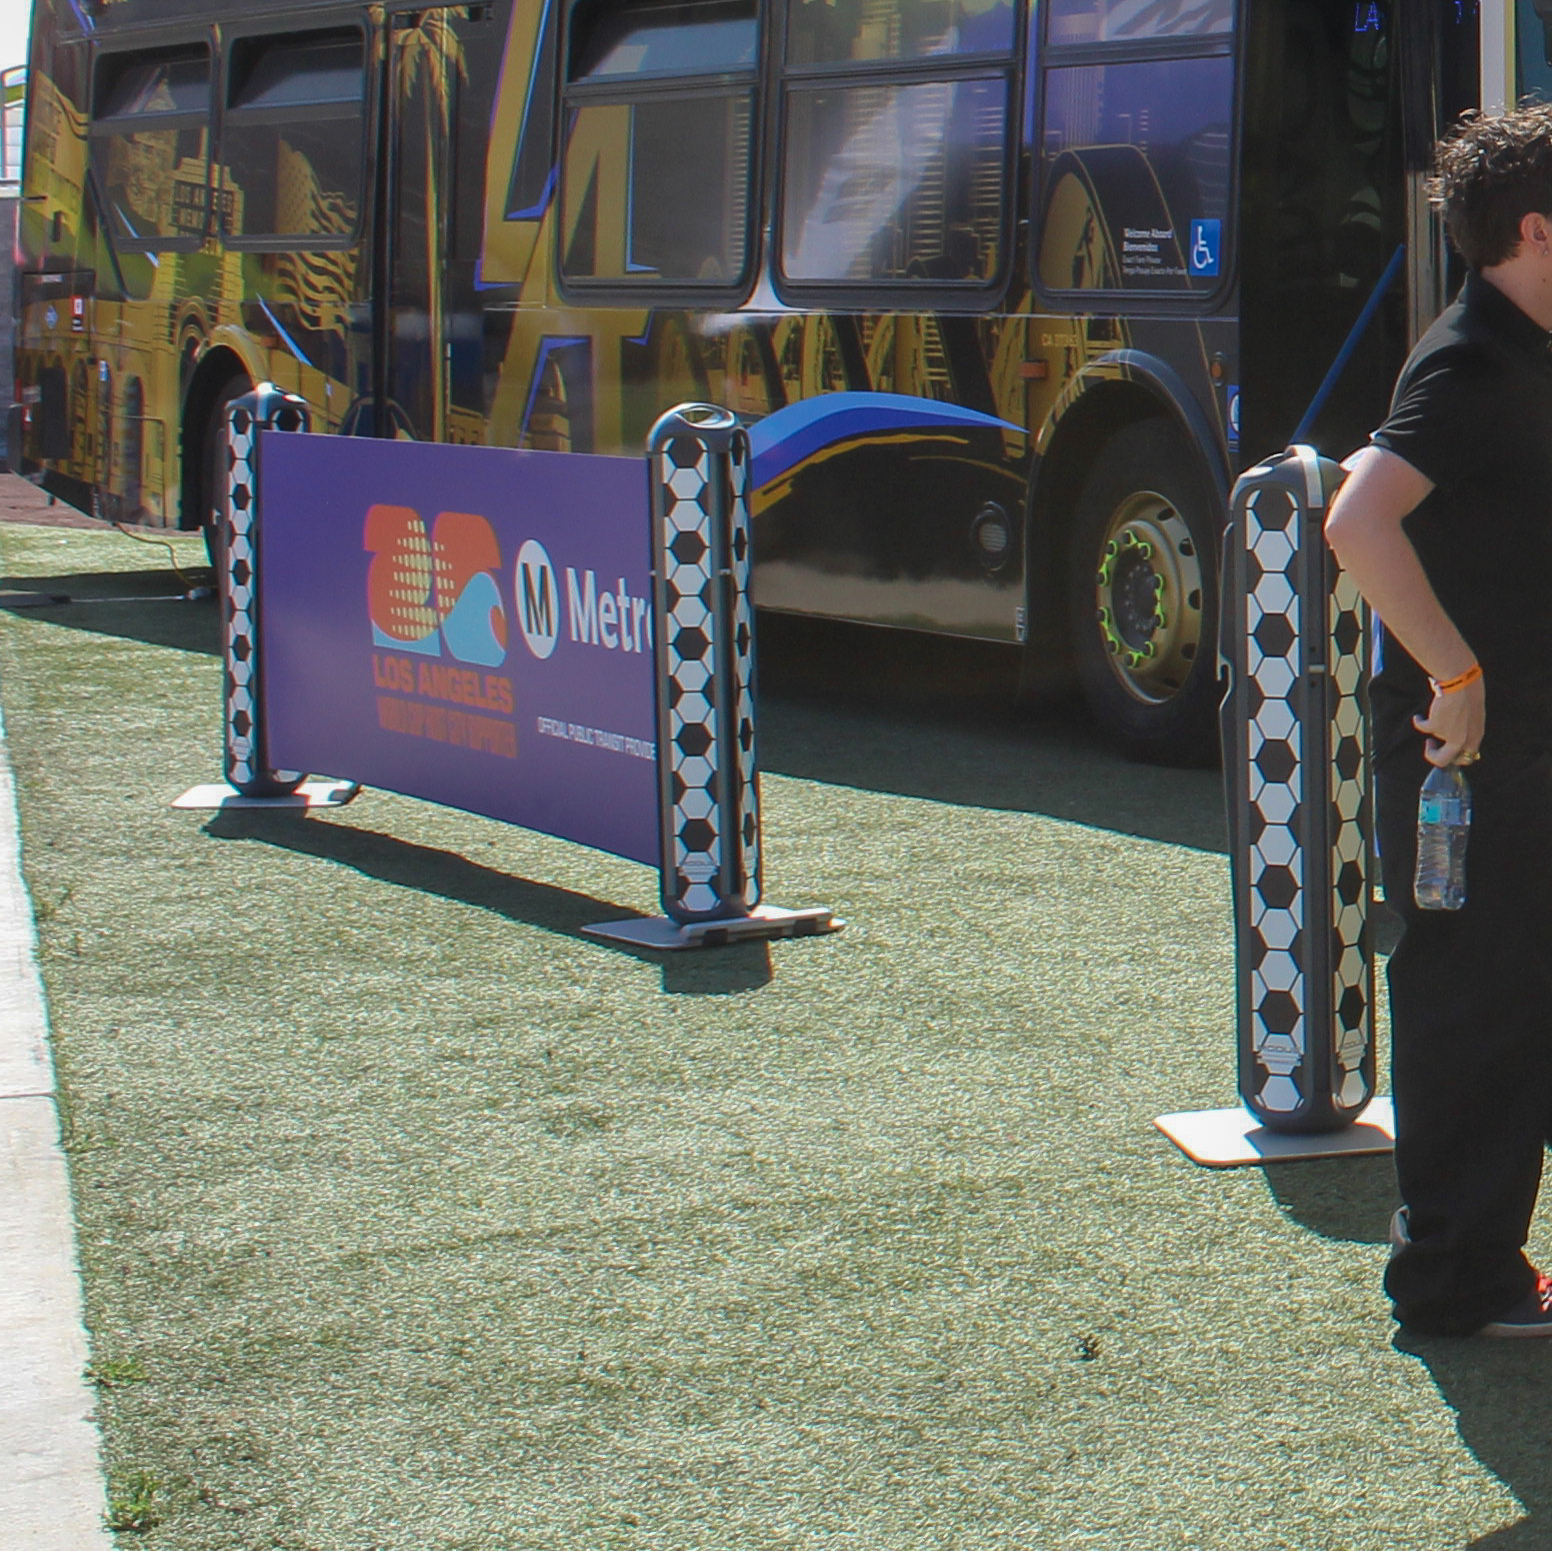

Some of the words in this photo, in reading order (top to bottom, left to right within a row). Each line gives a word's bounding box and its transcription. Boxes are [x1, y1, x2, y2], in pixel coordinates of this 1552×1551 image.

[371, 654, 414, 693] LOS
[417, 662, 515, 714] ANGELES
[625, 736, 657, 760] PROVIDE
